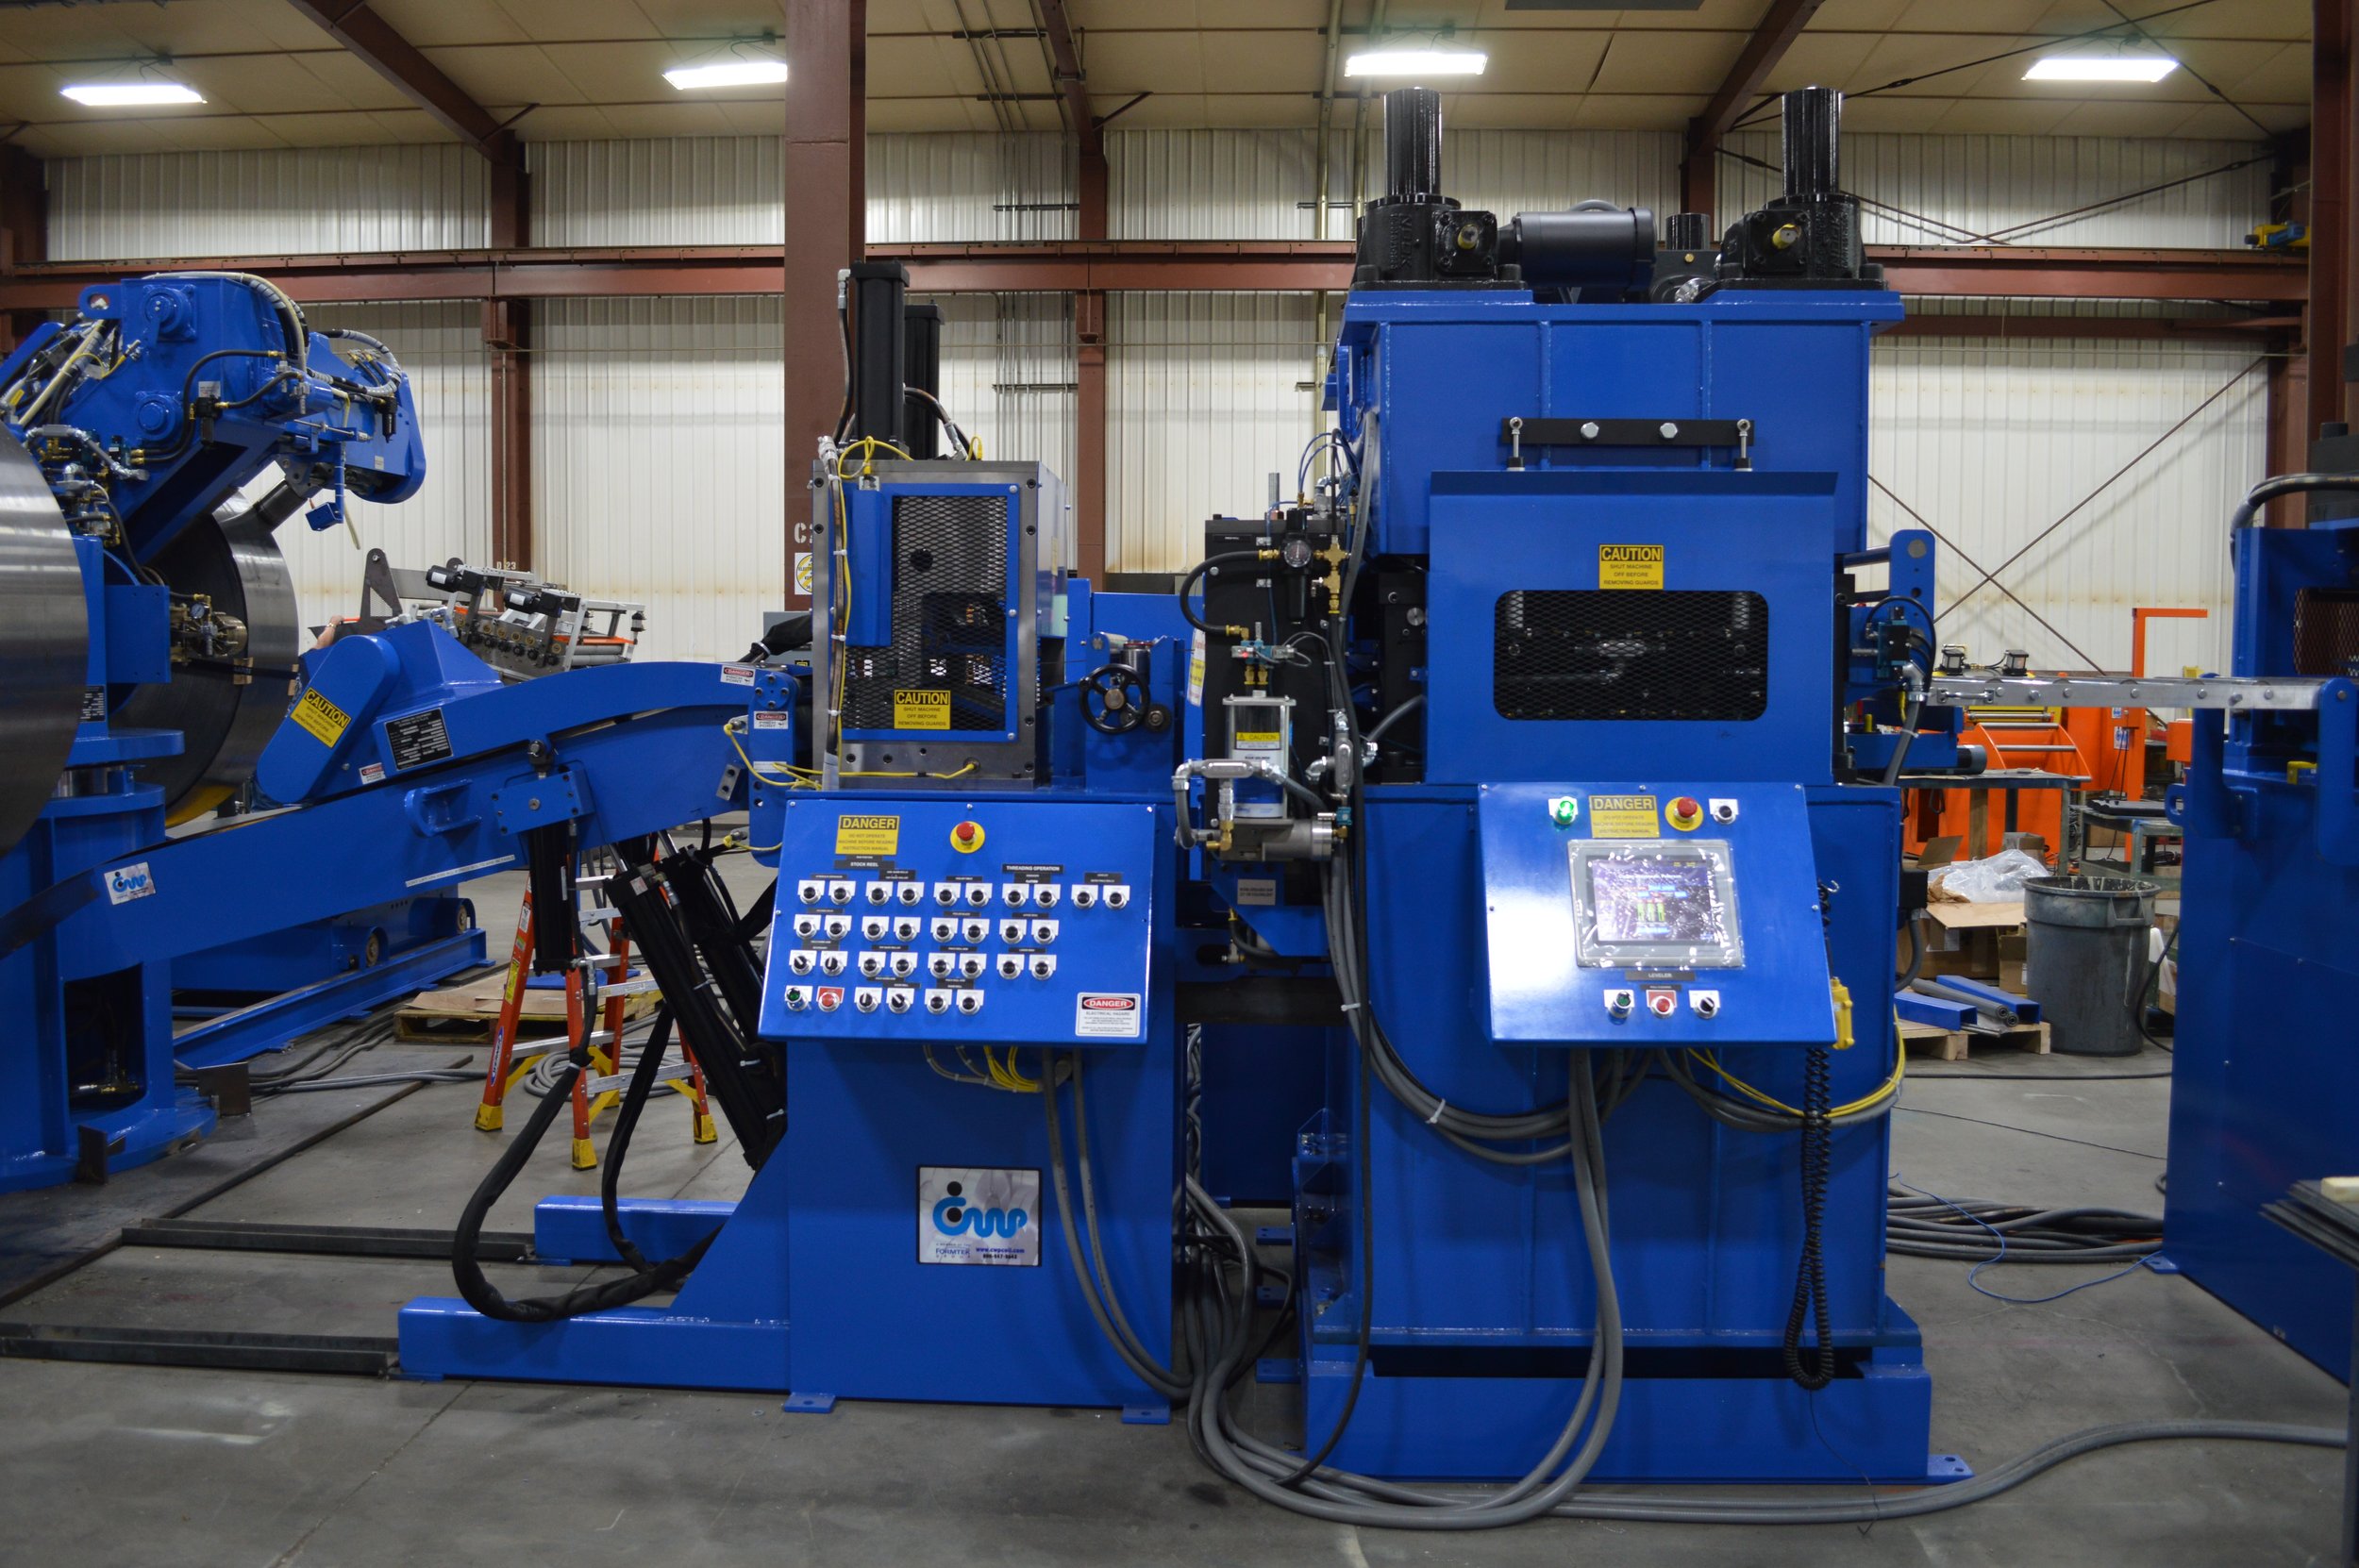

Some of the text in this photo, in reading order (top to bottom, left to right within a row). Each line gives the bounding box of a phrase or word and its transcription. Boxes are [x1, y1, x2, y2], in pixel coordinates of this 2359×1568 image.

[1602, 547, 1660, 560] CAUTION
[896, 692, 948, 705] CAUTION
[306, 691, 348, 727] CAUTION
[1594, 798, 1653, 809] DANGER
[843, 817, 895, 829] DANGER
